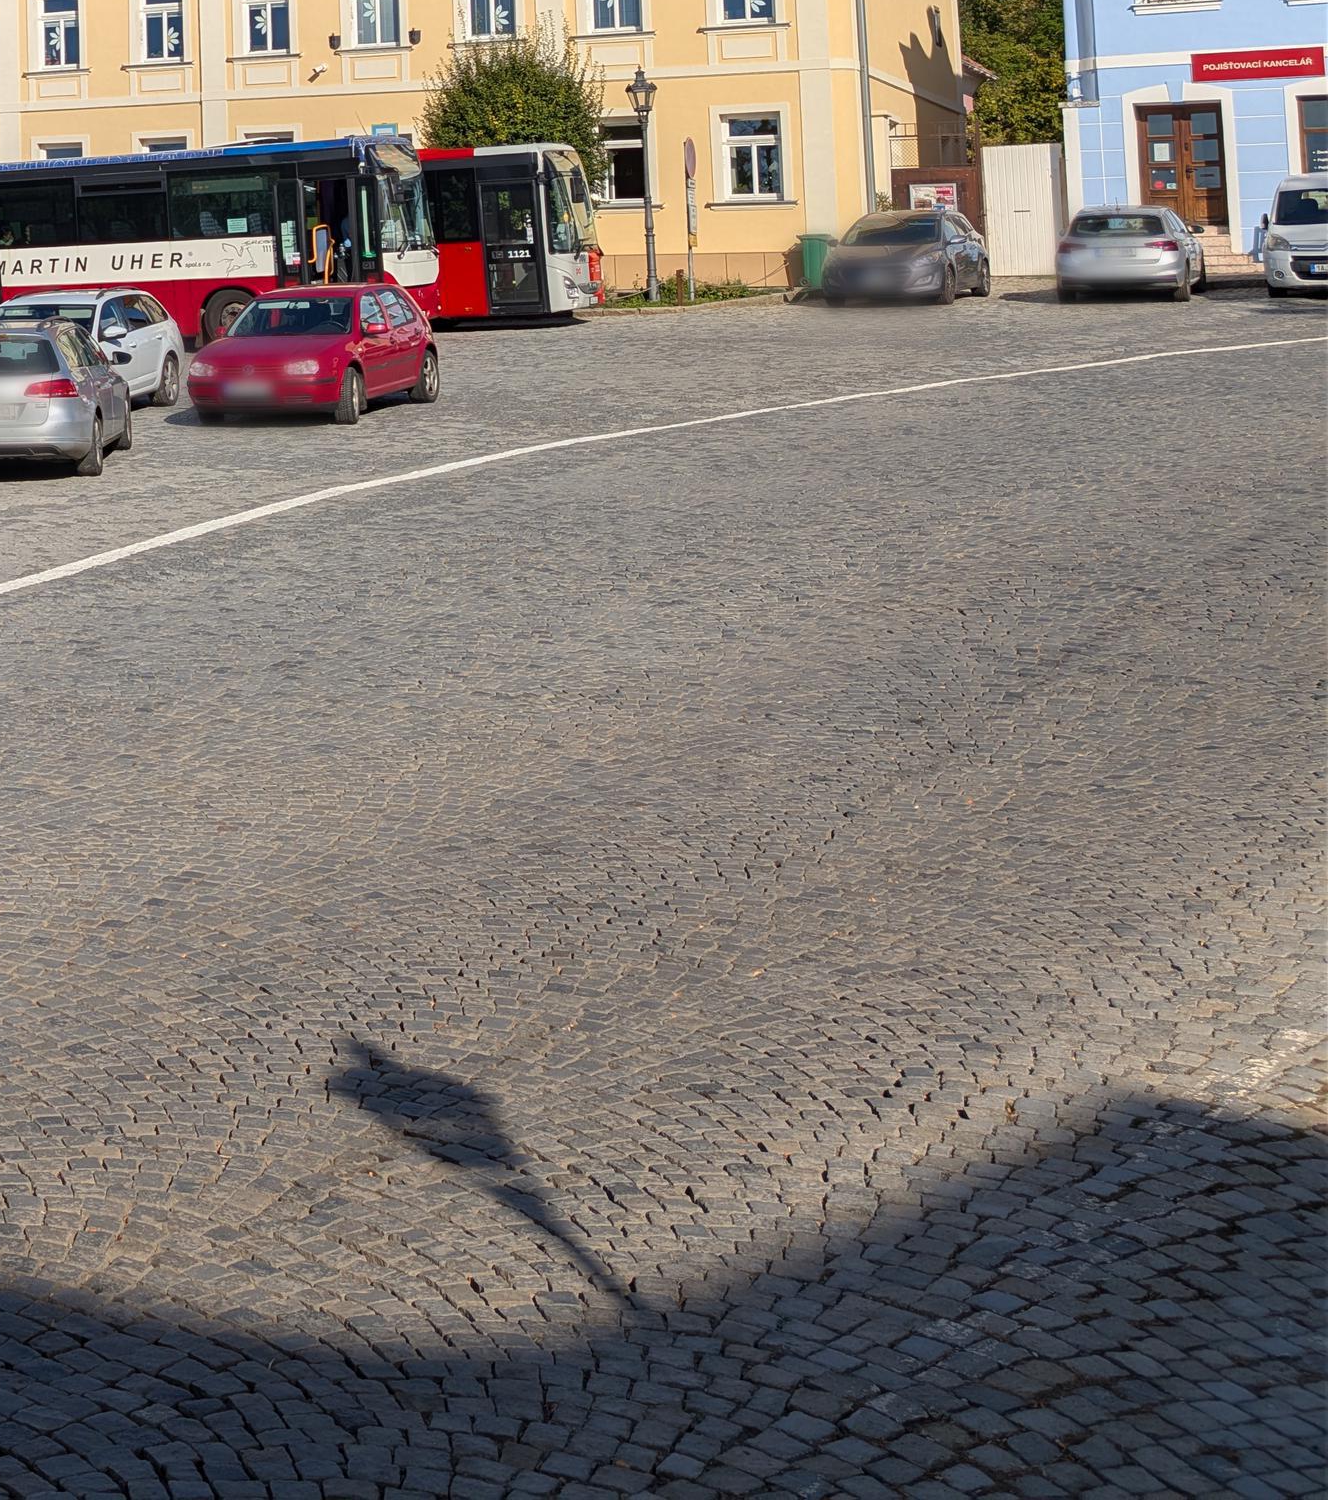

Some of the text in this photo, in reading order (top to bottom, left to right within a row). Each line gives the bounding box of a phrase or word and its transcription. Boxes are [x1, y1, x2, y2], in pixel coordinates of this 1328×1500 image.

[1203, 57, 1313, 71] POJIŠŤOVACÍ KANCELÁŘ
[507, 250, 532, 259] 1121
[0, 256, 88, 276] MARTIN
[111, 252, 184, 271] UHER
